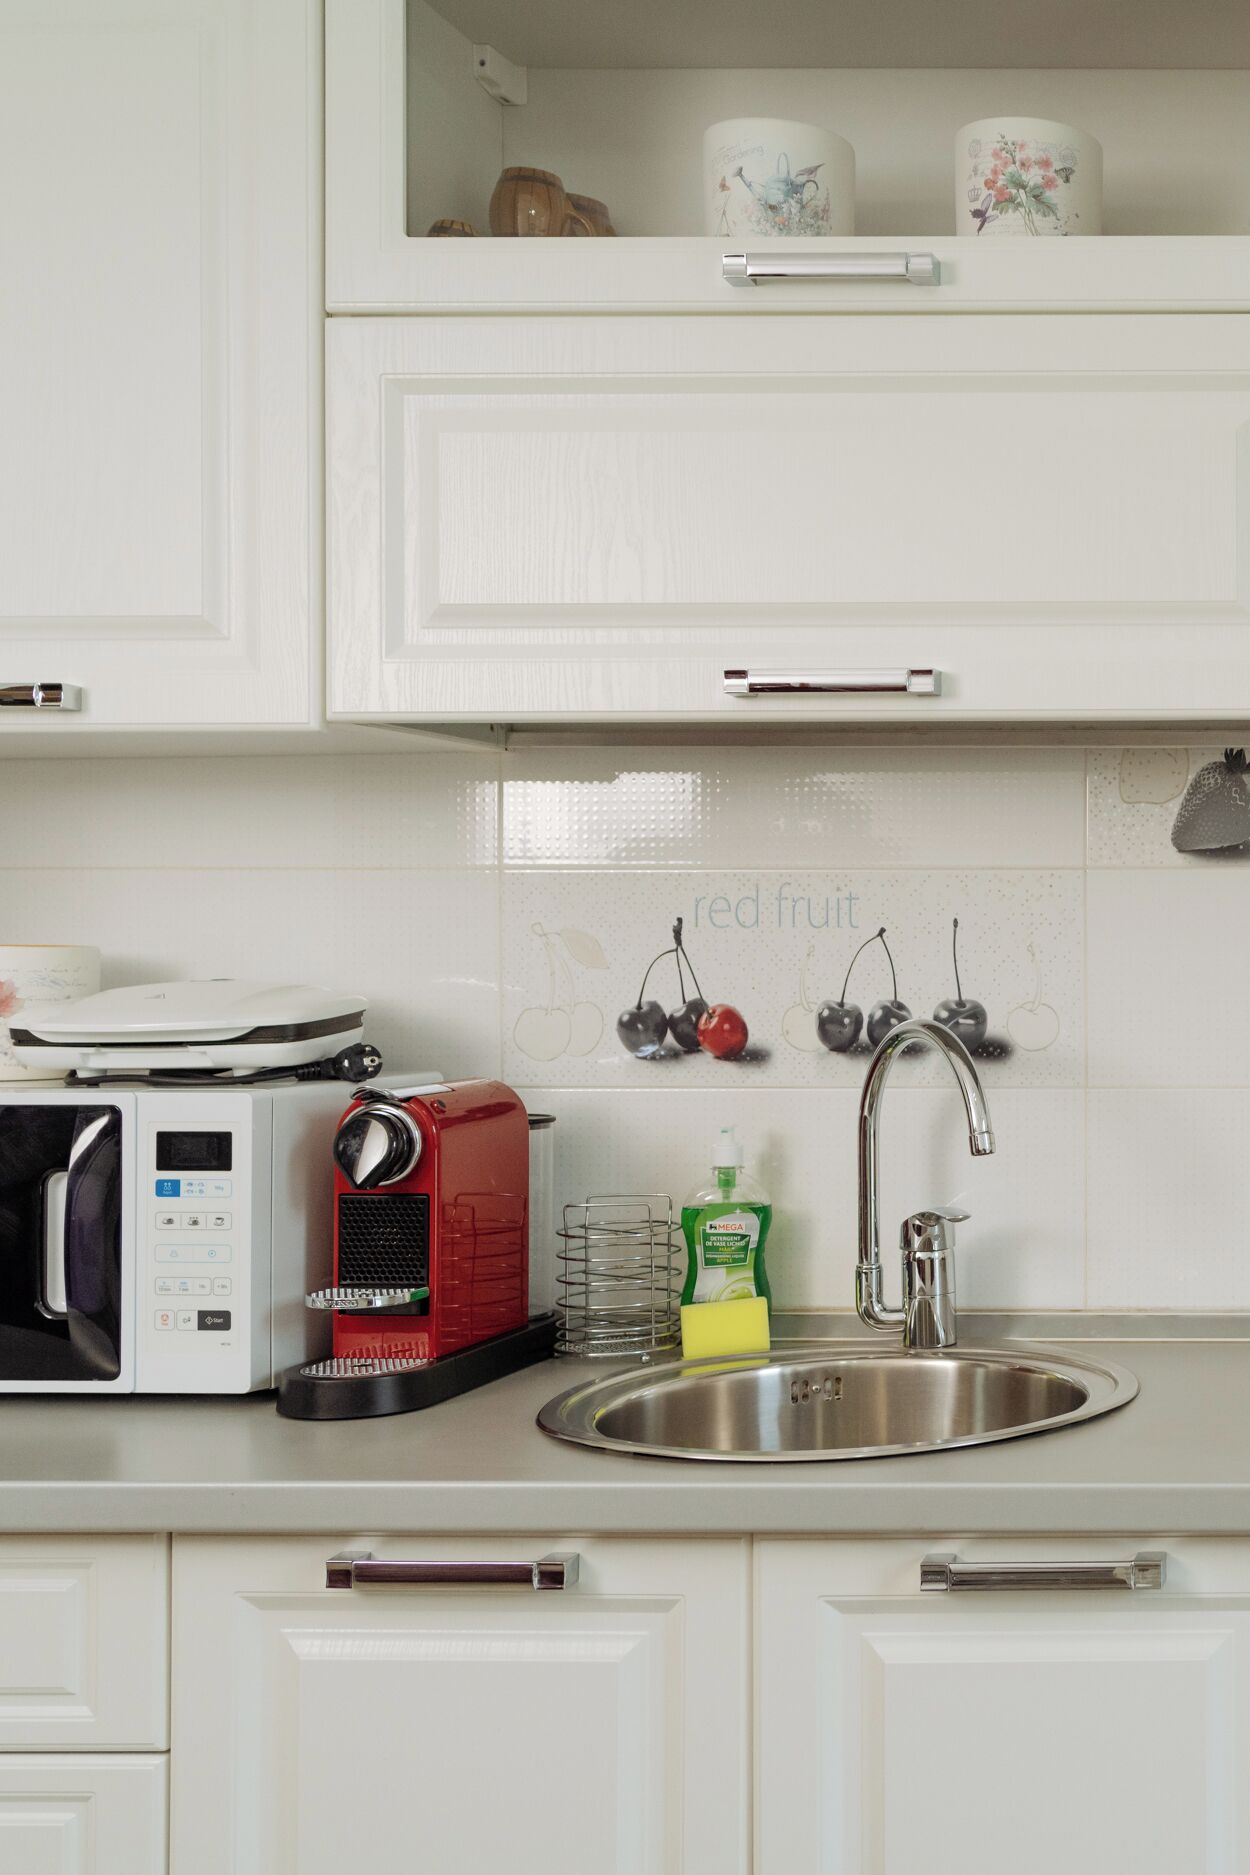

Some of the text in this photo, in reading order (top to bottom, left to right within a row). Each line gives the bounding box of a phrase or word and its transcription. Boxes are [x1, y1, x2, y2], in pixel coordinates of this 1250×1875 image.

[694, 881, 860, 929] red fruit
[717, 1223, 744, 1231] MEGA
